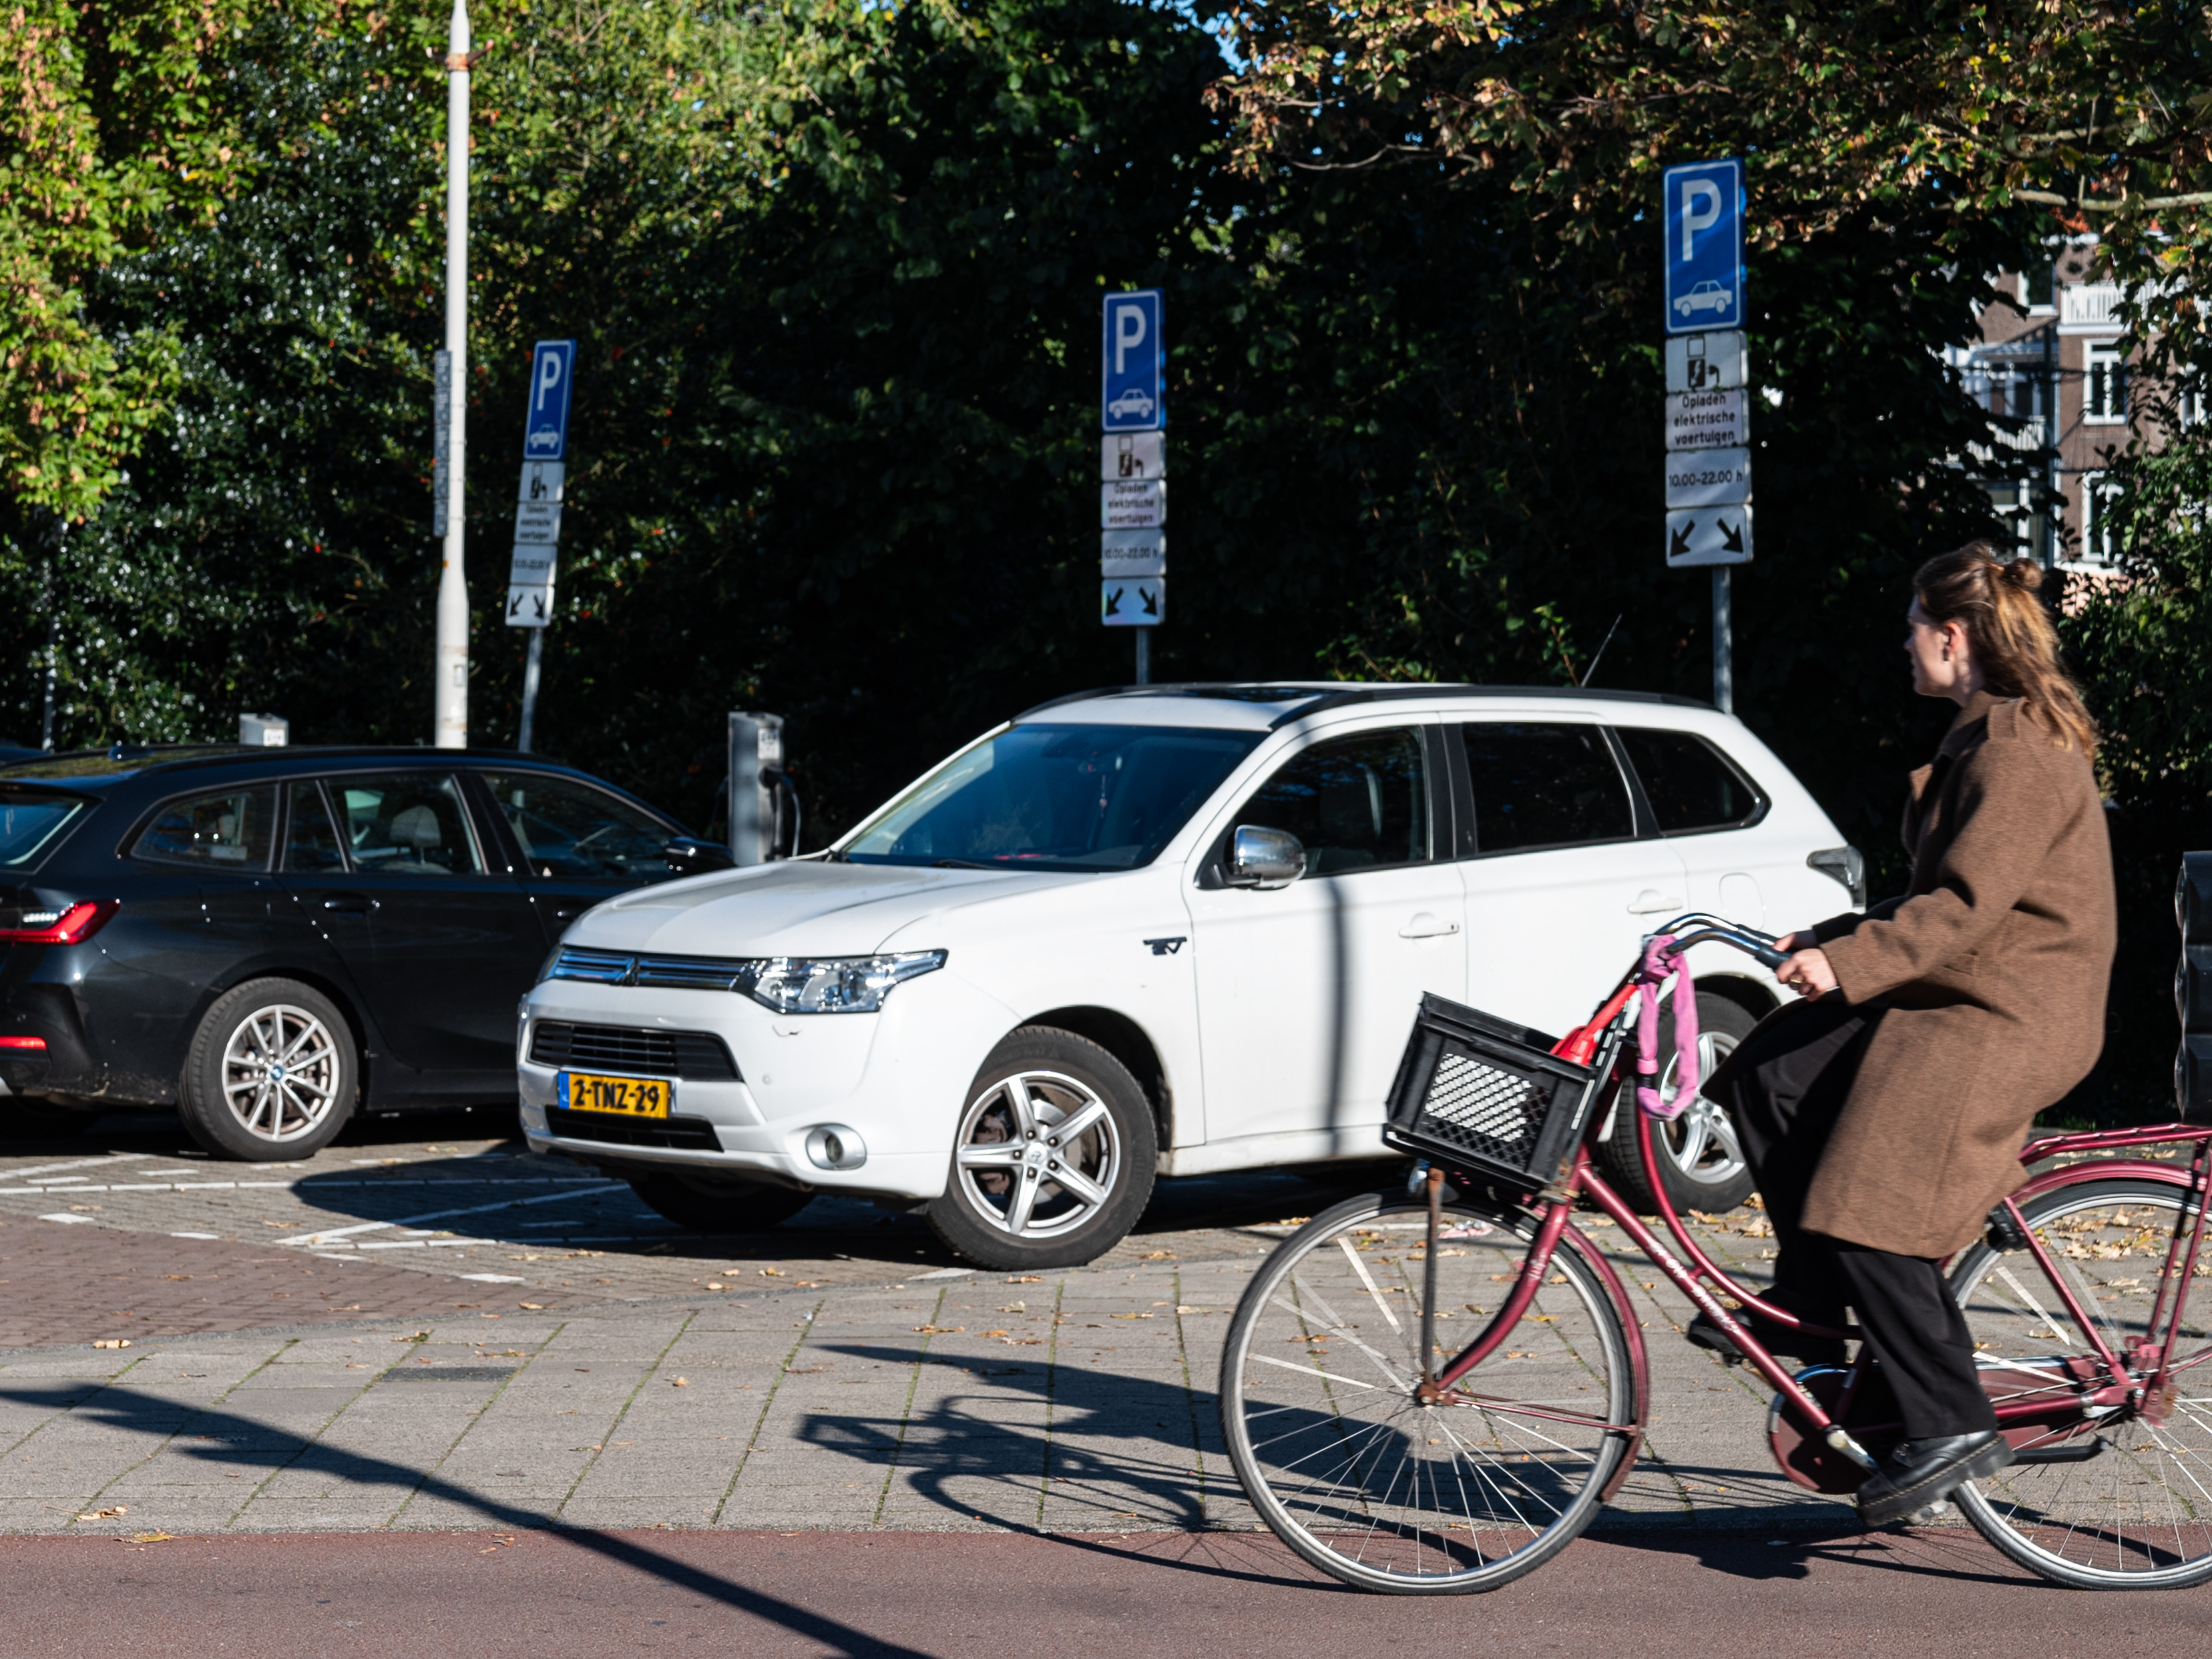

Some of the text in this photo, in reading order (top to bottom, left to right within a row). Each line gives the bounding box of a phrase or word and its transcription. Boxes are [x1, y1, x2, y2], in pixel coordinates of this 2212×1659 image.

[1682, 179, 1722, 261] P
[1116, 305, 1146, 373] P
[537, 352, 561, 411] P
[1683, 393, 1726, 409] Opladen
[1674, 411, 1735, 427] elektrische
[1675, 430, 1735, 445] voertuigen
[1669, 469, 1743, 487] 10.00-22.00 h
[573, 1079, 660, 1112] 2-TNZ-29
